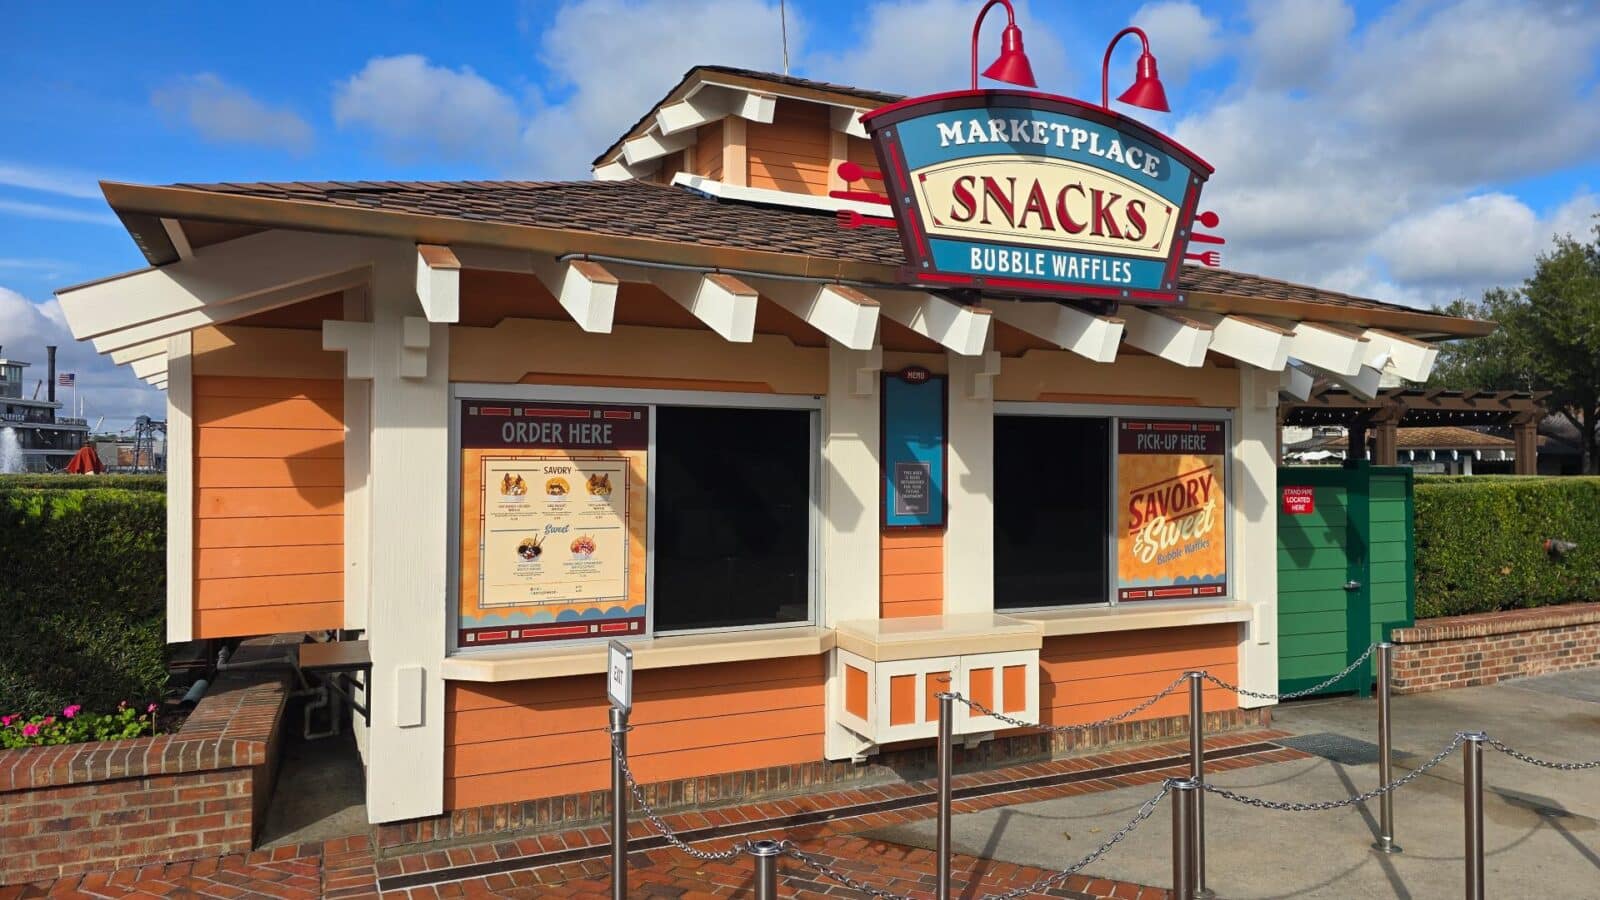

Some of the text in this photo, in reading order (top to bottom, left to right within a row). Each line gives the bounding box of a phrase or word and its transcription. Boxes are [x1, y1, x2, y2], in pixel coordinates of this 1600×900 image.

[936, 118, 1161, 177] MARKETPLACE
[950, 175, 1147, 242] SNACKS
[970, 247, 1132, 283] BUBBLE WAFFLES
[907, 370, 925, 380] MENU
[502, 421, 613, 444] ORDER HERE
[1137, 433, 1207, 450] PICK-UP HERE
[543, 466, 572, 475] SAVORY
[1128, 473, 1214, 530] SAVORY
[544, 523, 570, 535] Sweet
[1140, 498, 1217, 564] Sweet
[1156, 538, 1210, 565] Bubble Waffles
[613, 665, 624, 686] EXIT
